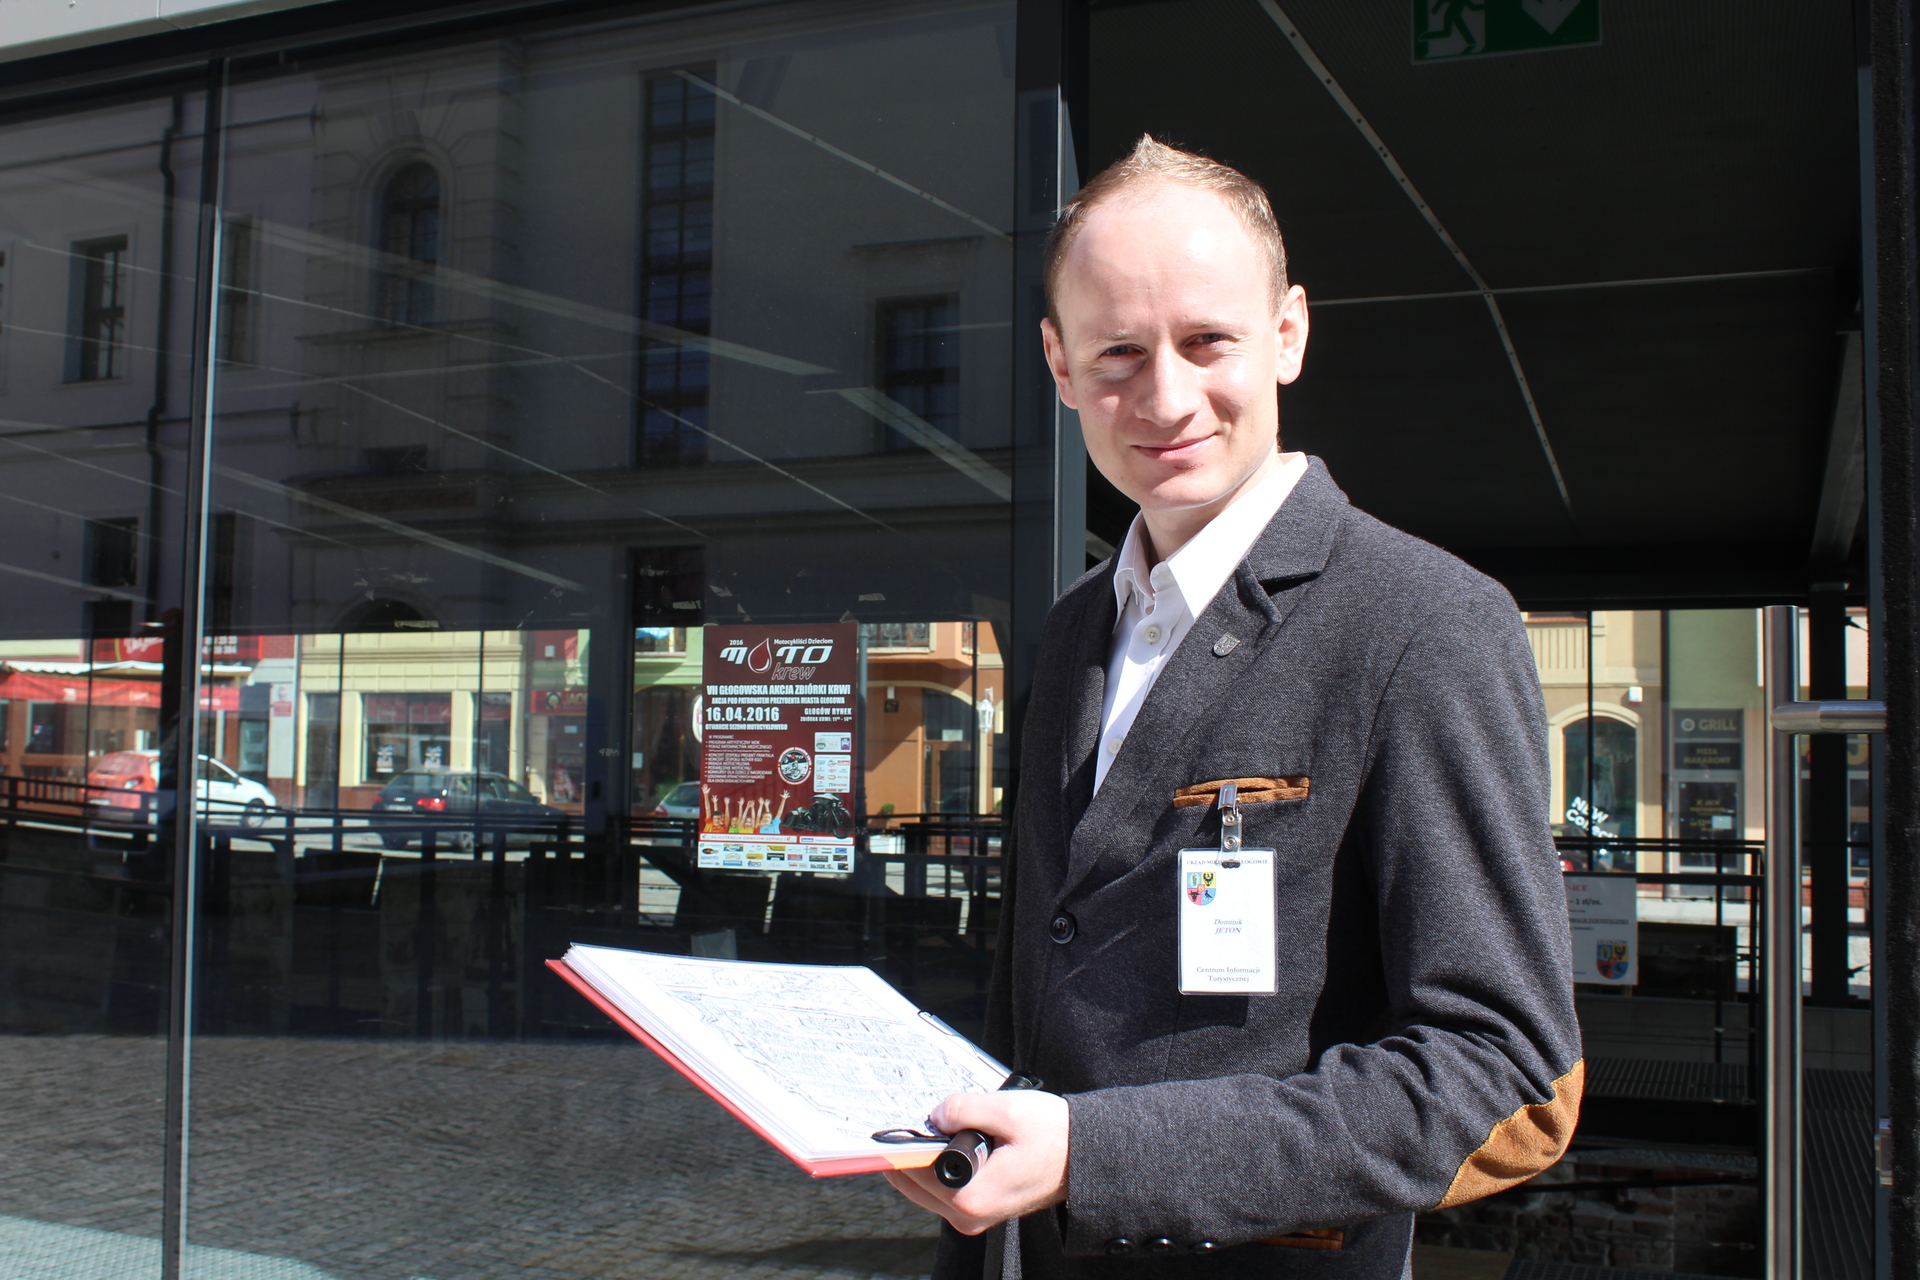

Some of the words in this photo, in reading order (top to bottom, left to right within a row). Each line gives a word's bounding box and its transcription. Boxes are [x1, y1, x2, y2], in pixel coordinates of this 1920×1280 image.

[772, 662, 815, 680] krew
[706, 685, 718, 695] VII
[719, 684, 768, 695] GŁOGOWSKA
[769, 684, 794, 695] AKCJA
[795, 682, 827, 695] ZBIÓRKI
[828, 684, 851, 695] KRWI
[706, 706, 780, 722] 16.04.2016
[804, 707, 830, 715] GŁOGÓW
[1698, 719, 1737, 731] GRILL
[1226, 966, 1260, 974] Informacji
